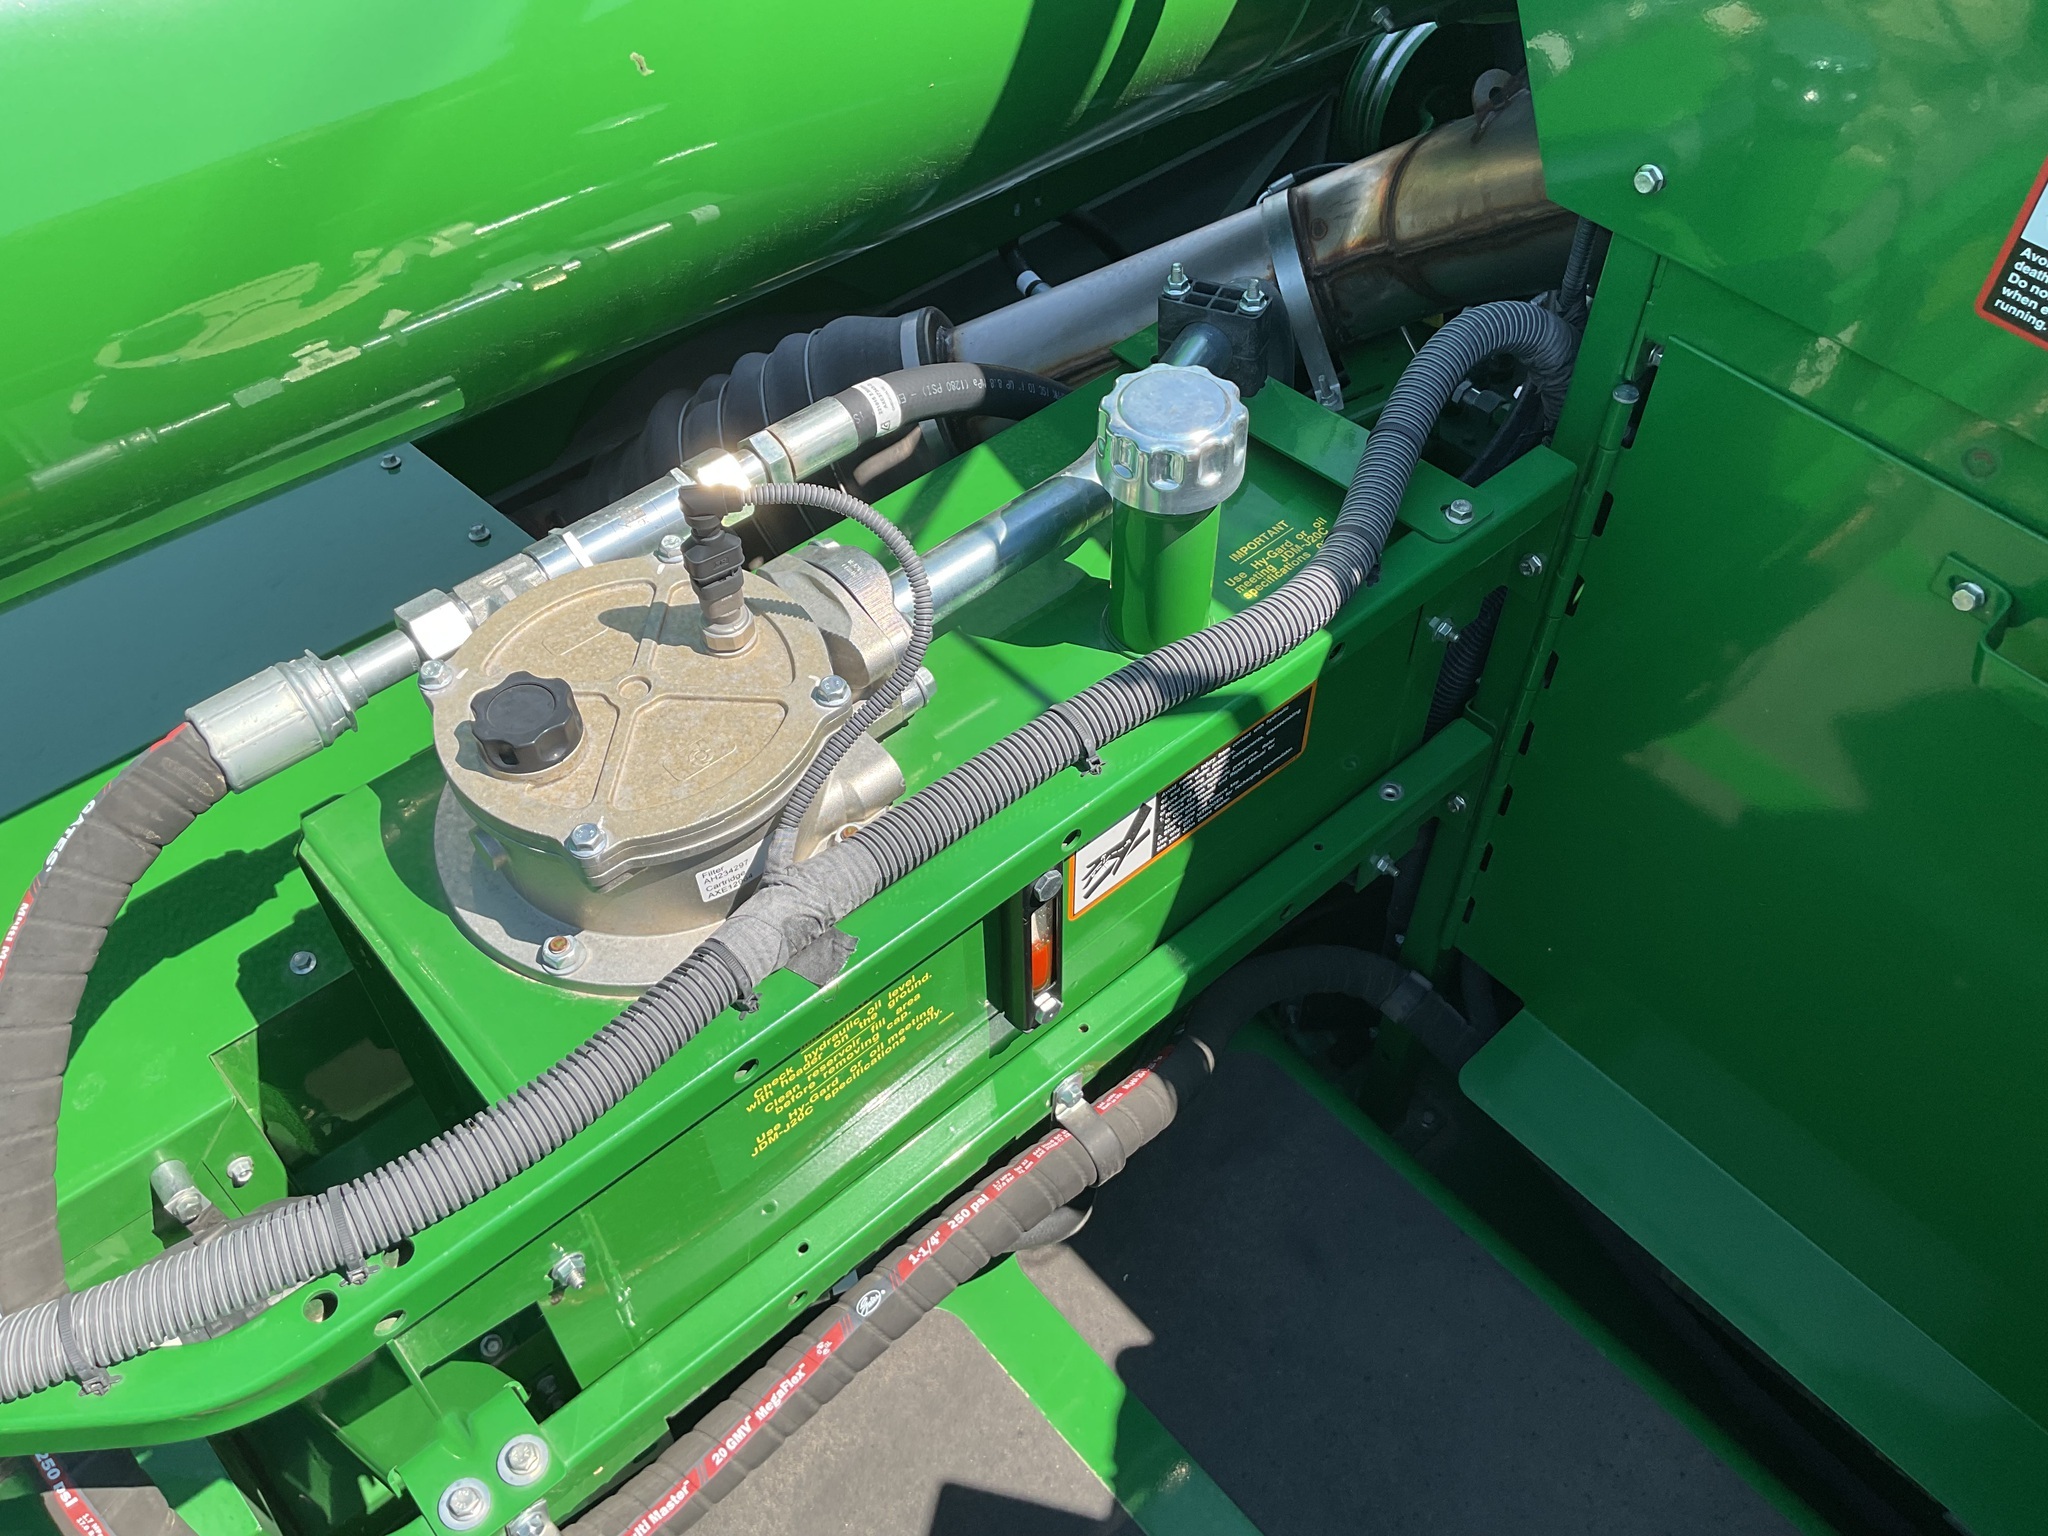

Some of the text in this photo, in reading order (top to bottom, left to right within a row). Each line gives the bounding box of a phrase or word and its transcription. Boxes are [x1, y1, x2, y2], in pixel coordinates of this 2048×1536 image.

[2001, 286, 2039, 310] when
[2007, 272, 2048, 300] Do no
[1994, 297, 2048, 331] running.
[922, 382, 943, 397] PSI)
[946, 379, 969, 392] (1280
[1224, 516, 1328, 587] Use Hy-Gard or oil
[1229, 519, 1289, 562] IMPORTANT
[1234, 527, 1329, 594] meeting JDM-J20C
[1243, 551, 1312, 600] specifications
[701, 866, 725, 879] Filter
[703, 859, 749, 885] AH234297
[706, 870, 746, 892] Cartridge
[5, 902, 29, 942] Multi
[745, 1090, 774, 1113] with
[780, 1052, 823, 1088] header
[833, 1034, 849, 1049] on
[859, 1012, 878, 1030] the
[888, 973, 933, 1010] ground.
[753, 1066, 794, 1099] Check
[803, 1017, 861, 1062] hydraulic
[867, 1000, 882, 1016] oil
[888, 974, 916, 1000] level
[764, 1083, 801, 1113] Clean
[806, 1038, 861, 1082] reservoir
[871, 1017, 886, 1034] fill
[895, 993, 921, 1015] area
[751, 1105, 815, 1158] JDM-J20C
[824, 1035, 907, 1102] specifications
[916, 1009, 943, 1032] only.
[756, 1123, 782, 1144] Use
[788, 1077, 840, 1120] Hy-Gard
[850, 1060, 863, 1074] or
[869, 1043, 885, 1058] oil
[887, 1005, 935, 1043] meeting
[774, 1081, 816, 1115] before
[823, 1032, 880, 1079] removing
[886, 1010, 912, 1031] cap.
[907, 1193, 991, 1266] 1-1/4" 250 psi
[711, 1447, 729, 1467] 20
[35, 1453, 79, 1508] 250 psi
